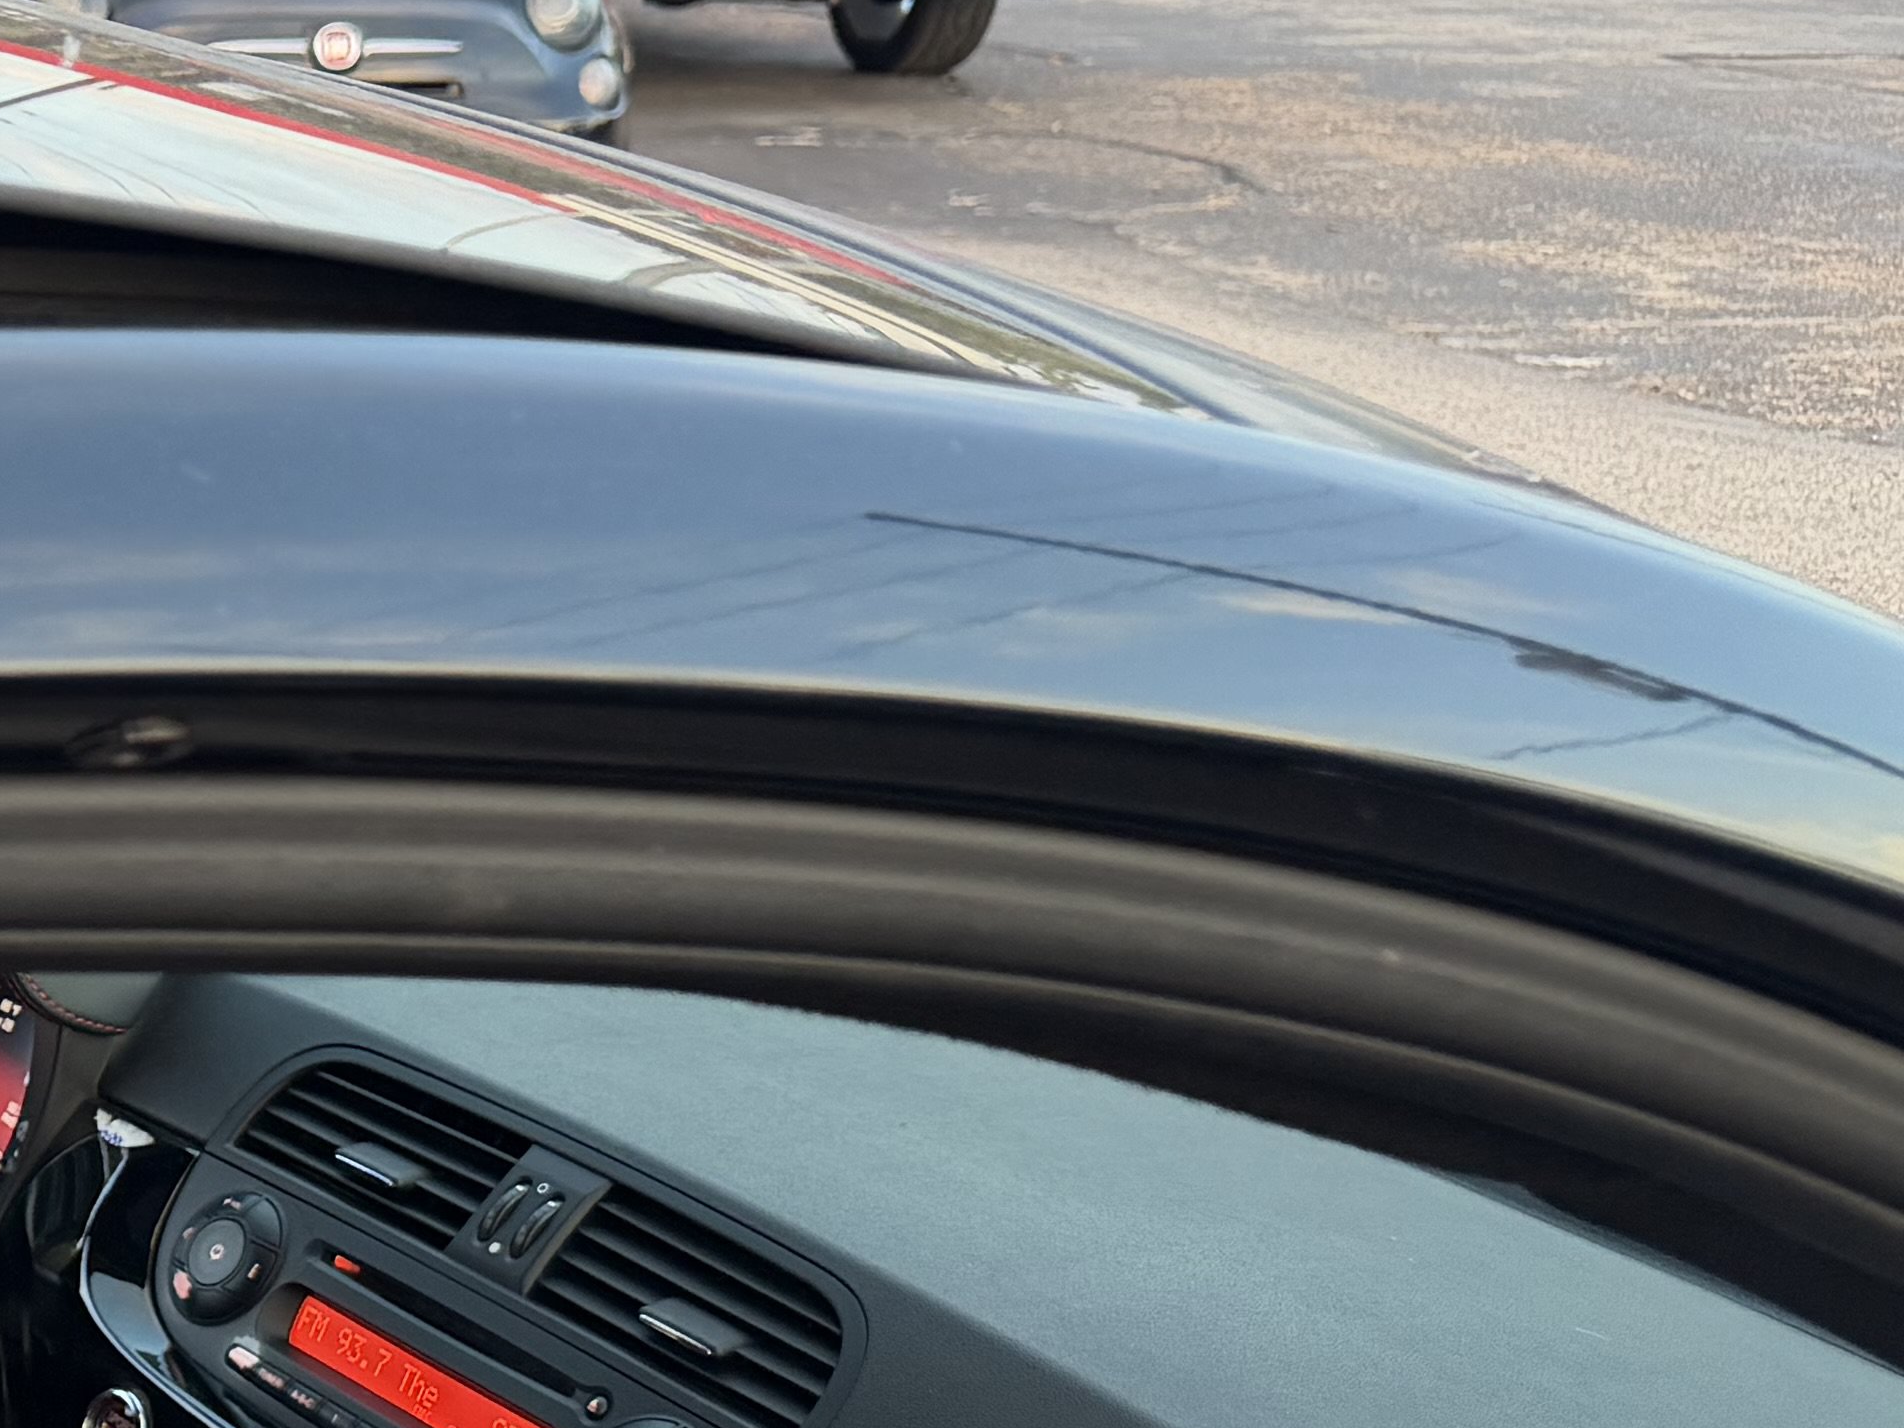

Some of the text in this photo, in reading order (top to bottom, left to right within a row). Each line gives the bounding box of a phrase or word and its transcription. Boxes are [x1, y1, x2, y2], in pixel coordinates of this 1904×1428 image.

[296, 1307, 330, 1342] FM
[336, 1327, 392, 1377] 93.7
[397, 1363, 439, 1408] The
